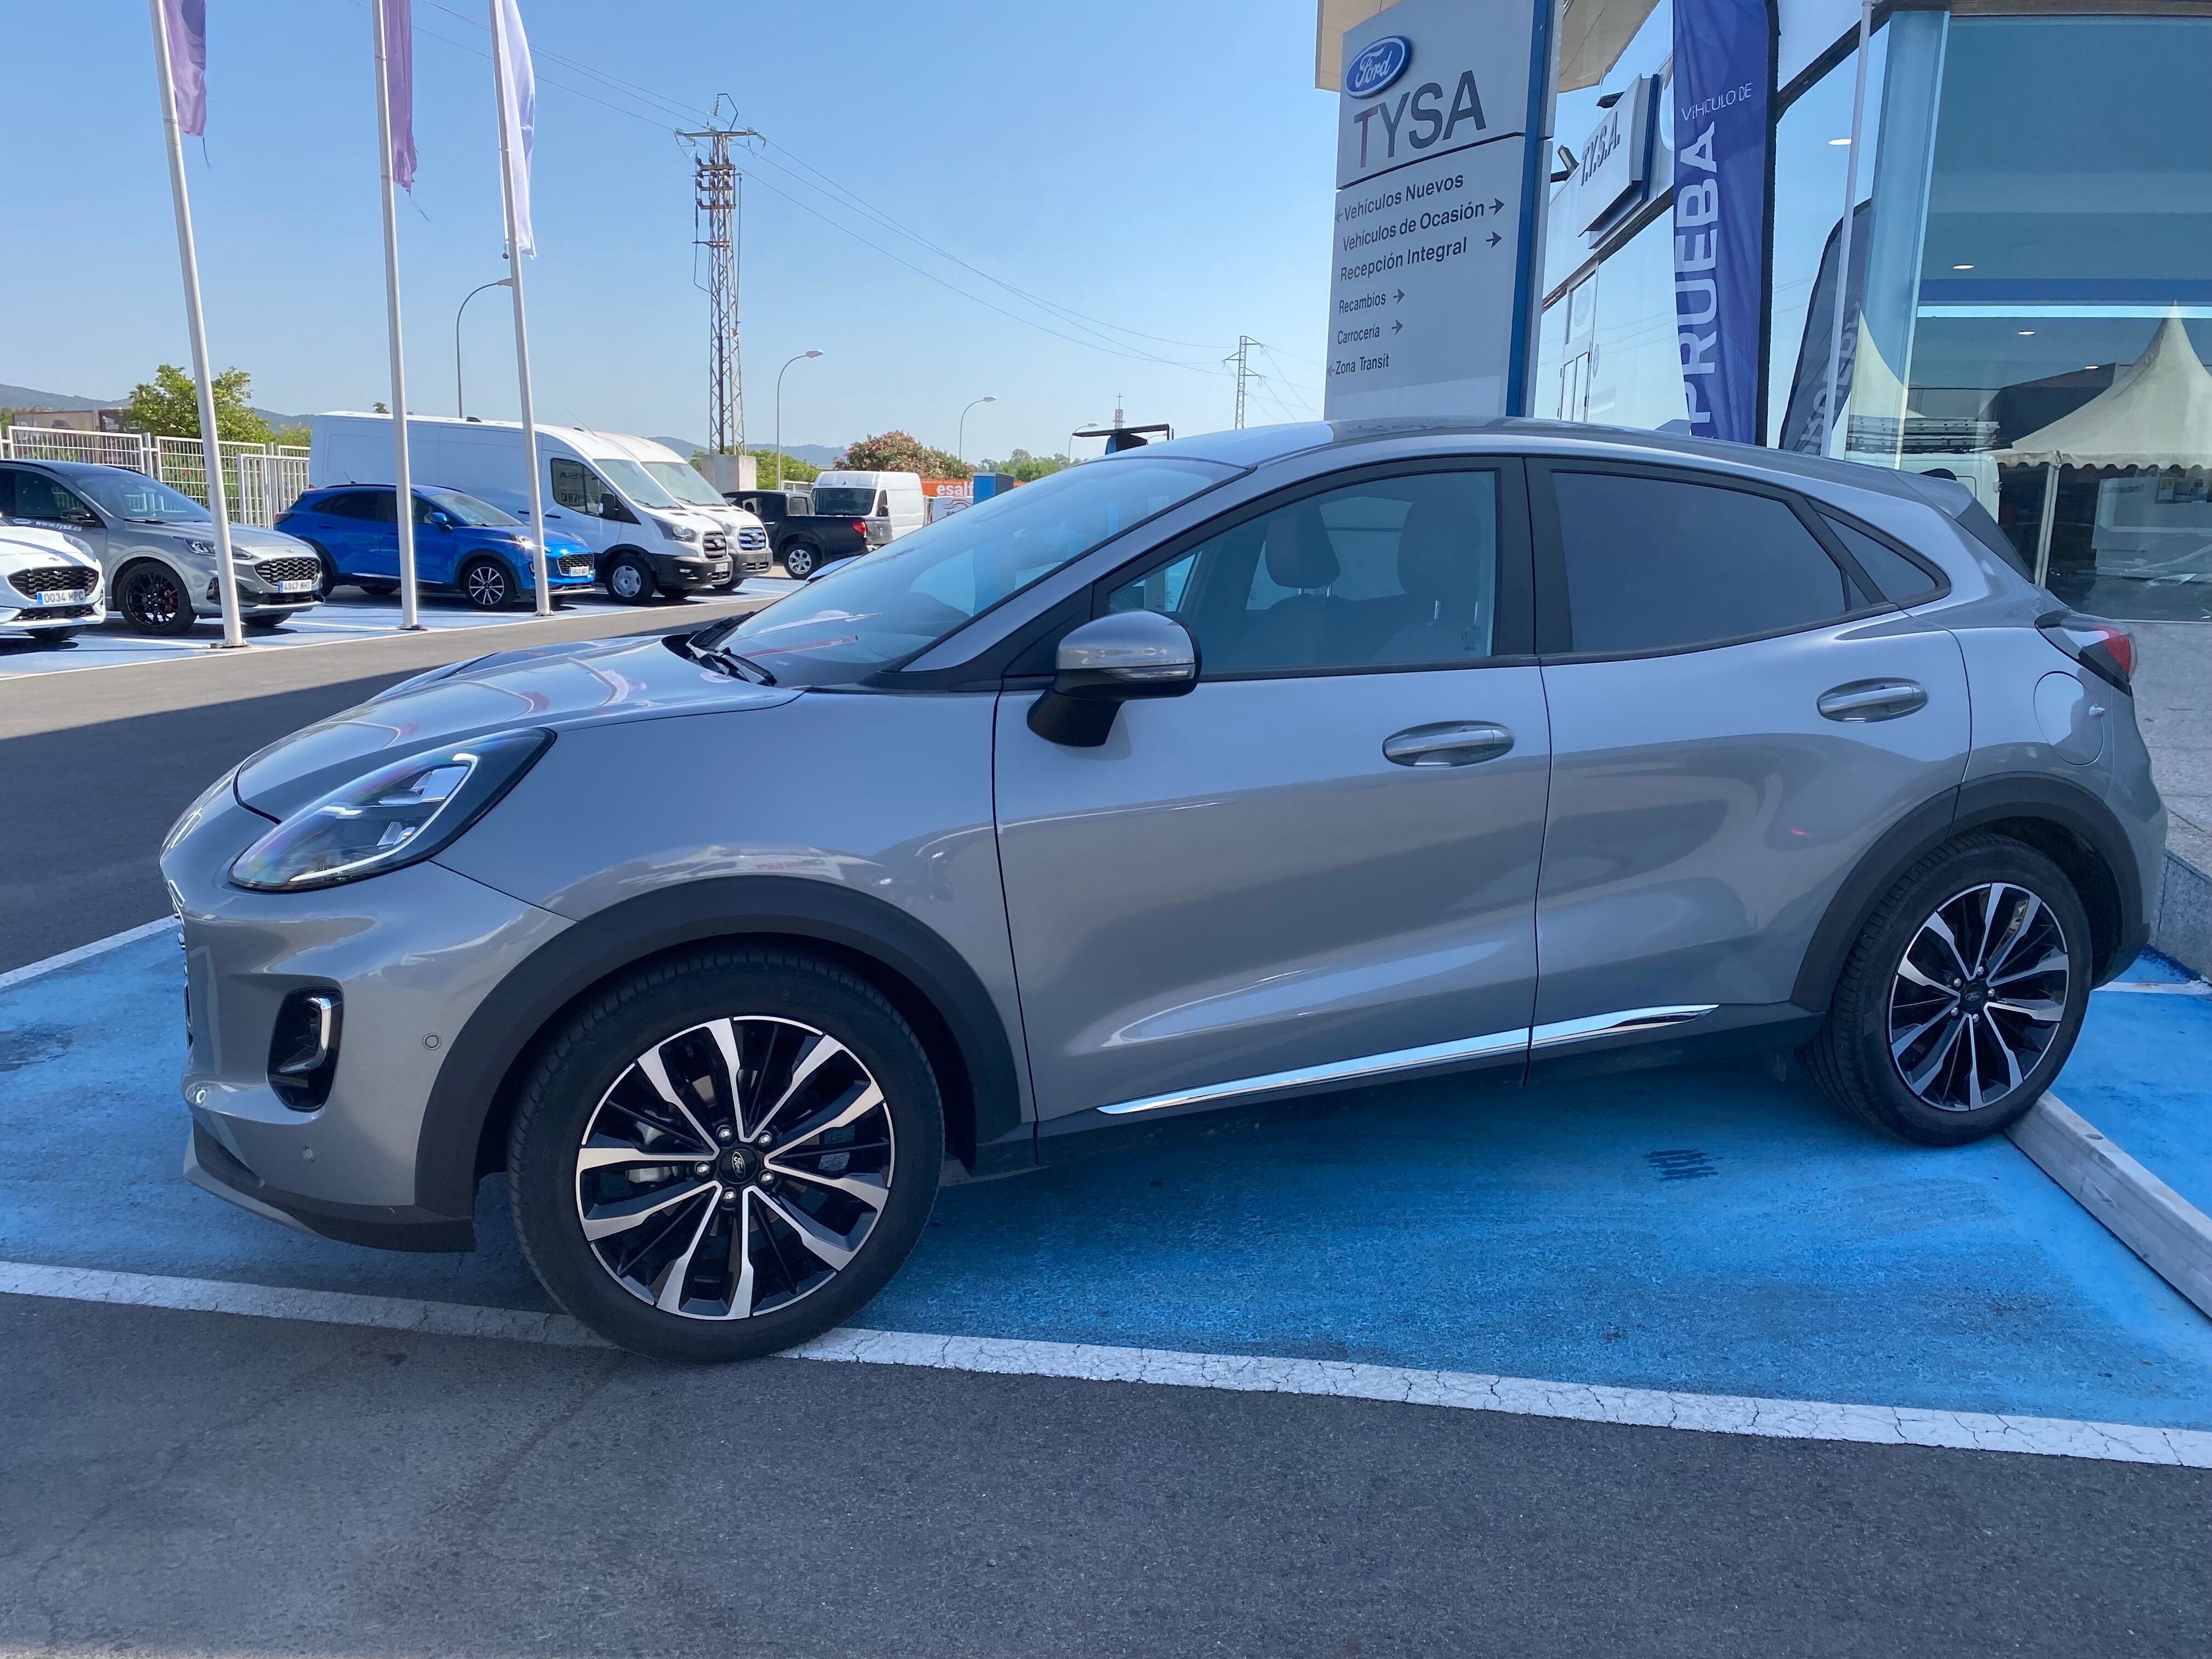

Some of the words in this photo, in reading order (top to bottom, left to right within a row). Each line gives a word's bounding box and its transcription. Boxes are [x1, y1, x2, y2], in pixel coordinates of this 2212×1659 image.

[1739, 82, 1752, 101] DE
[1353, 70, 1486, 168] TYSA
[1581, 111, 1620, 186] T.Y.S.A.
[1344, 191, 1402, 221] Vehículos
[1406, 174, 1464, 202] Nuevos
[1343, 224, 1396, 251] Vehículos
[1400, 218, 1417, 235] de
[1420, 202, 1485, 229] Ocasión
[1340, 252, 1403, 282] Recepción
[1407, 236, 1467, 265] Integral
[1675, 121, 1718, 424] PRUEBA
[1339, 292, 1386, 314] Recambios
[1337, 324, 1380, 345] Carrocería
[1335, 359, 1356, 375] Zona
[1359, 353, 1389, 371] Transit
[36, 521, 82, 532] www.tysa.es
[44, 592, 66, 603] 0034
[69, 591, 83, 601] MPC
[284, 582, 298, 590] 4947
[300, 582, 311, 590] MHS
